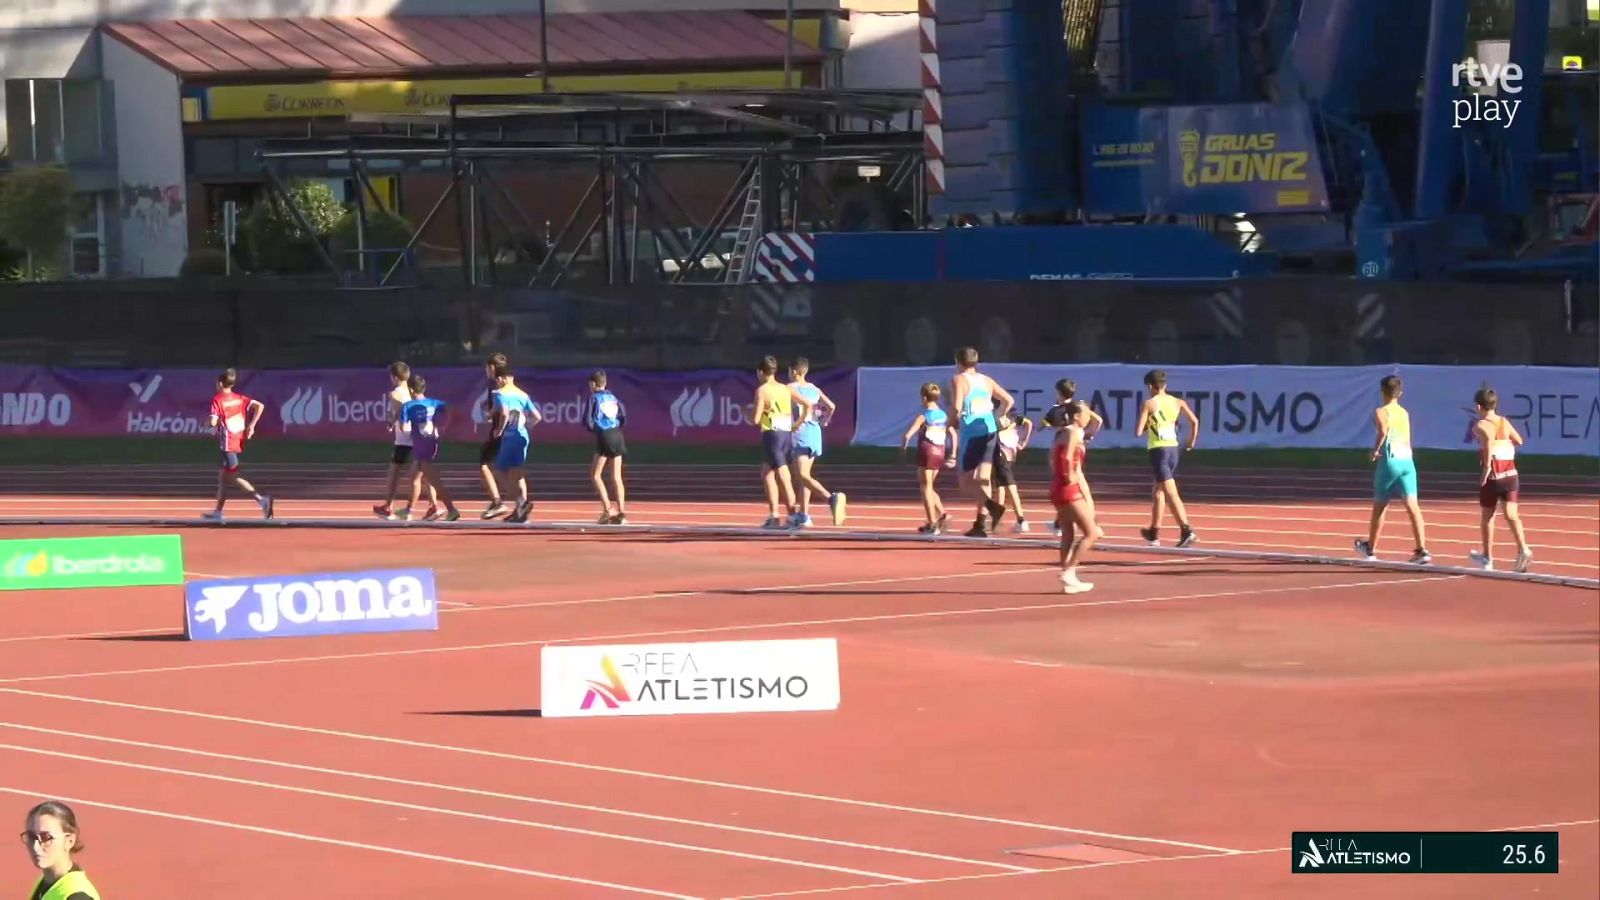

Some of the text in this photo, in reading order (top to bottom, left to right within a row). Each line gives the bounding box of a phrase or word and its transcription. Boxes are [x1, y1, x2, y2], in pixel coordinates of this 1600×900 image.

[1205, 133, 1275, 152] GRUAS
[1202, 152, 1308, 182] DONIZ
[0, 392, 71, 426] NDO
[329, 393, 387, 423] Iberd
[127, 411, 197, 434] Halcón
[52, 553, 164, 575] Iberdrola
[637, 675, 808, 702] ATLETISMO
